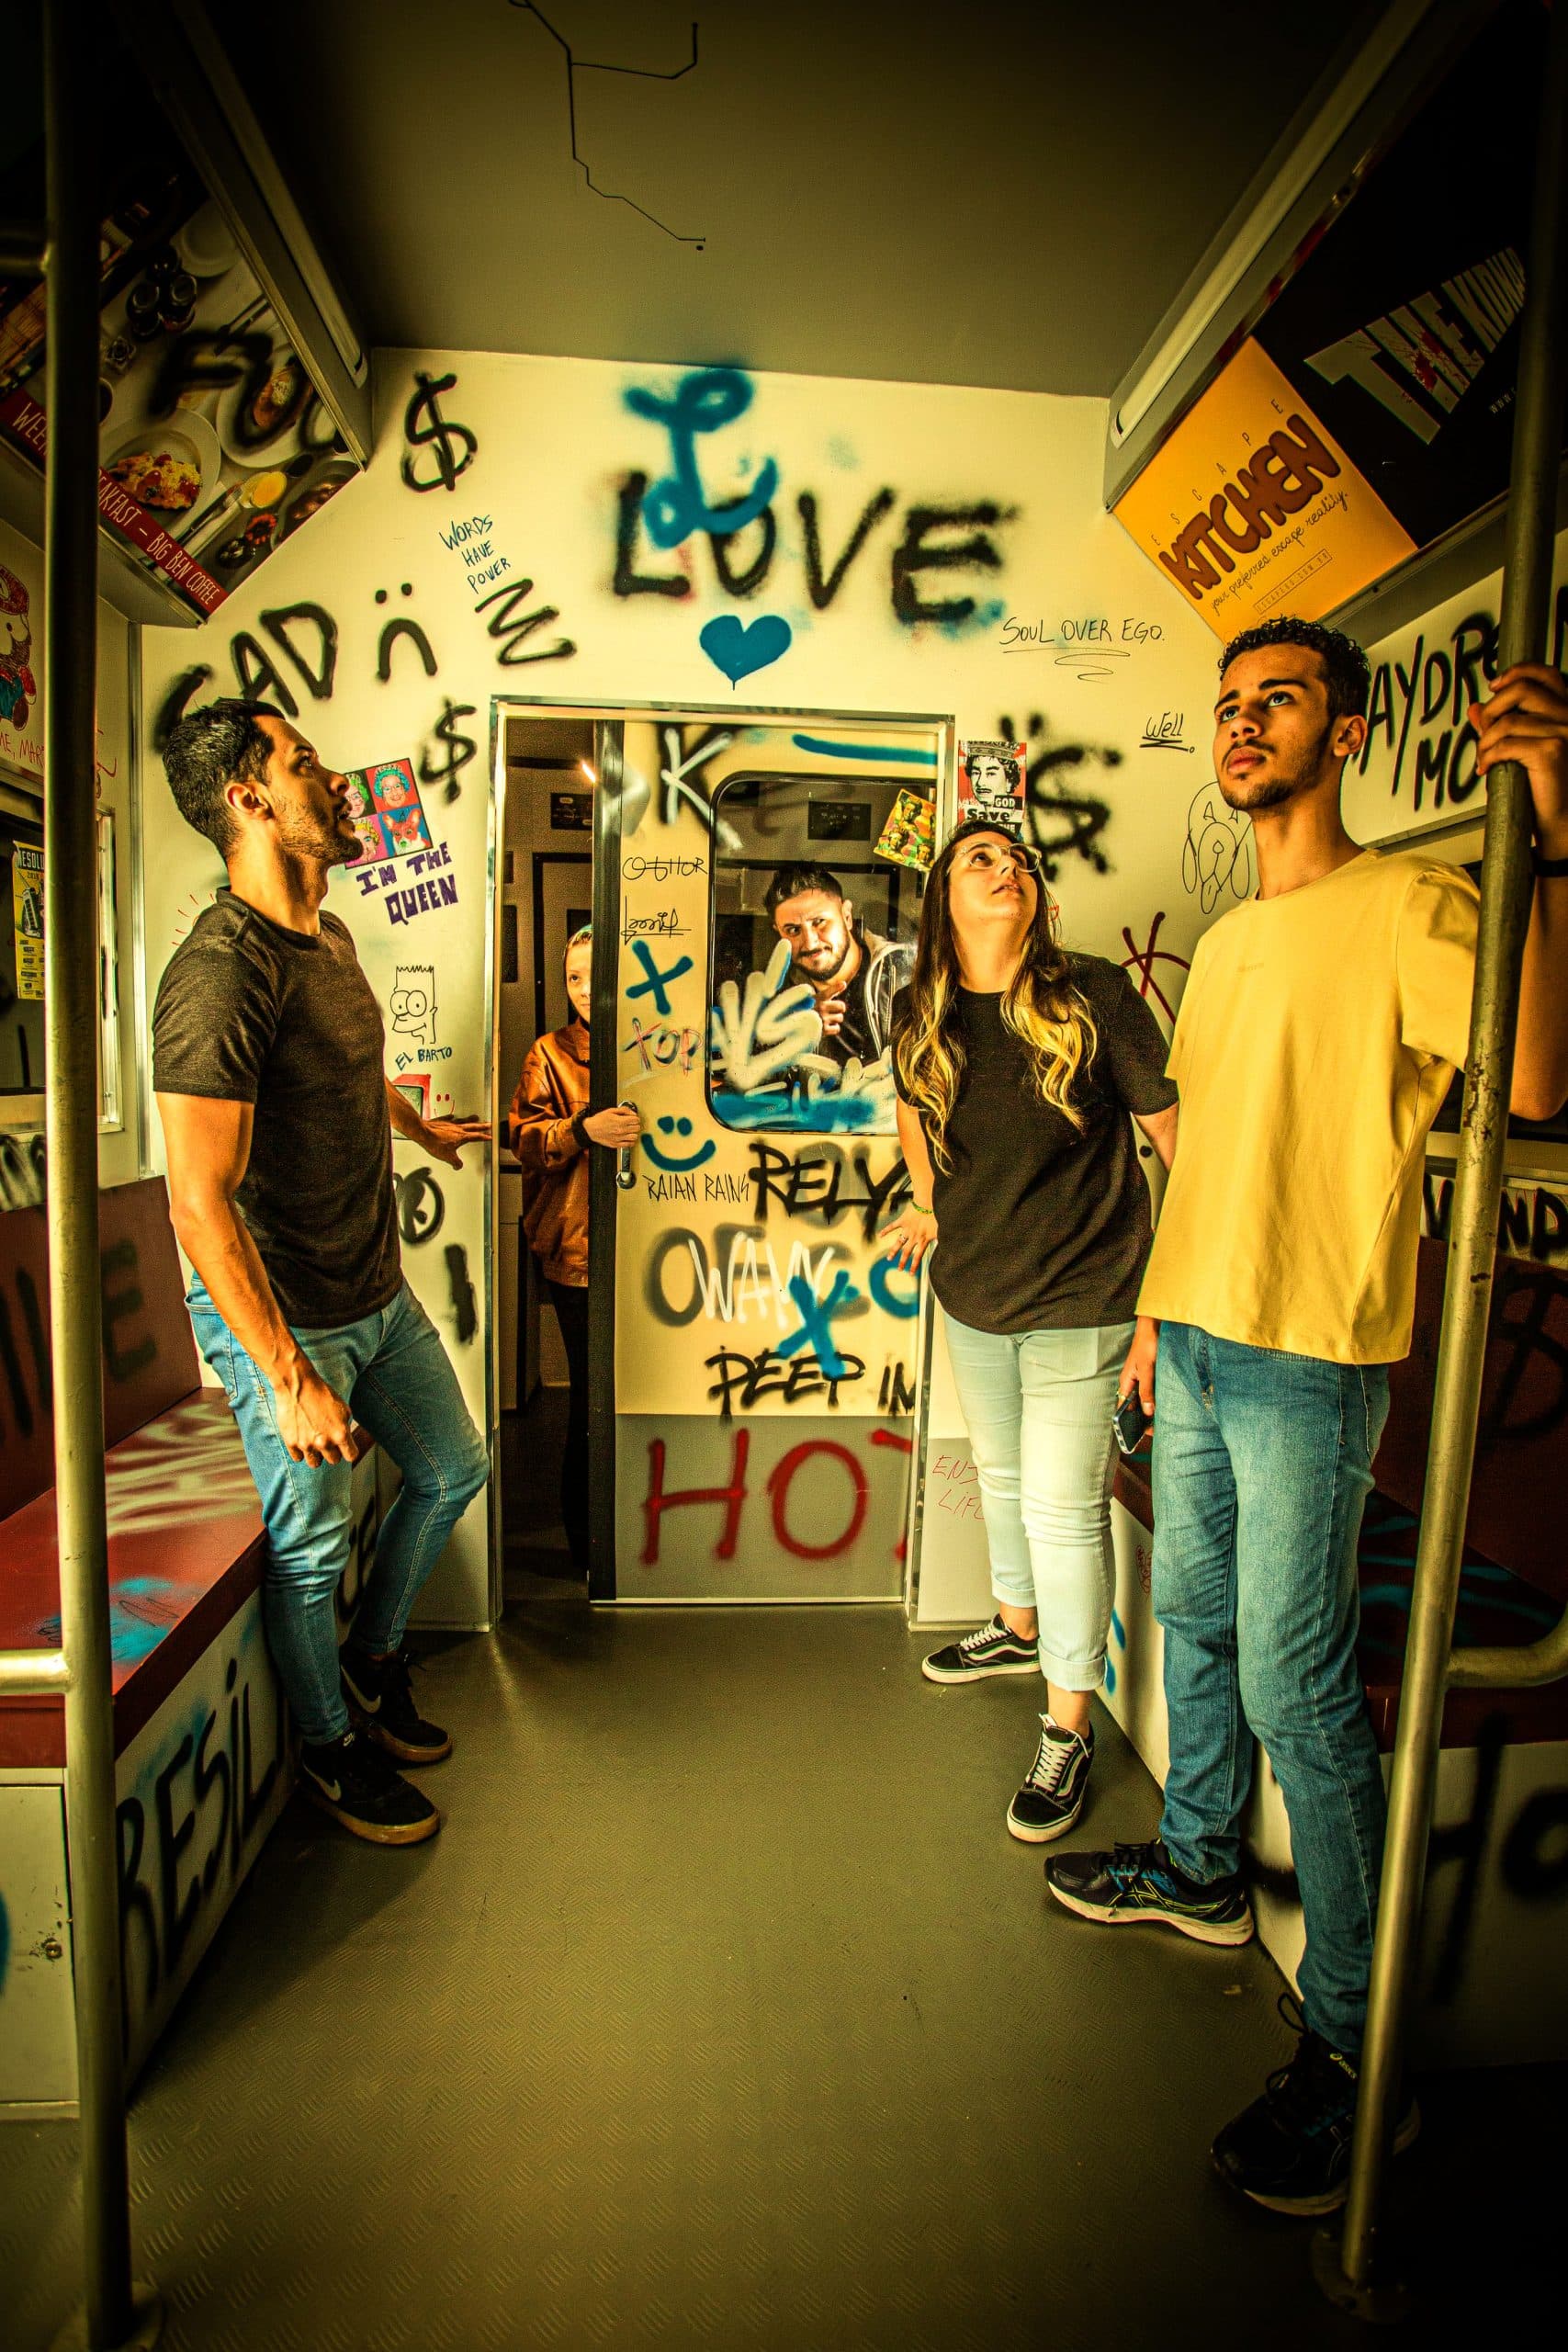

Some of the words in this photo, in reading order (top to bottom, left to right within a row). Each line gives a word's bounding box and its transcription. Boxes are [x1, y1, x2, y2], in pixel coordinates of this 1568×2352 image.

[1302, 289, 1485, 447] THE
[1151, 398, 1284, 546] ESCAPE
[1158, 413, 1341, 600] KITCHEN
[97, 469, 142, 527] AKFAST
[146, 531, 173, 560] BIG
[167, 549, 192, 579] BEN
[186, 571, 220, 605] COFFEE
[438, 514, 494, 551] WORDS
[461, 539, 495, 568] HAVE
[611, 467, 1018, 625] LOVE
[1272, 526, 1305, 558] escape
[467, 557, 512, 595] POWER
[998, 616, 1055, 645] SOUL
[1061, 618, 1112, 642] OVER
[966, 808, 1010, 822] Save
[995, 797, 1016, 808] GOD
[355, 864, 398, 897] I'M
[406, 841, 453, 876] THE
[384, 873, 459, 926] QUEEN
[395, 1051, 414, 1071] EL
[417, 1046, 453, 1063] BARTO
[639, 1427, 915, 1568] HO
